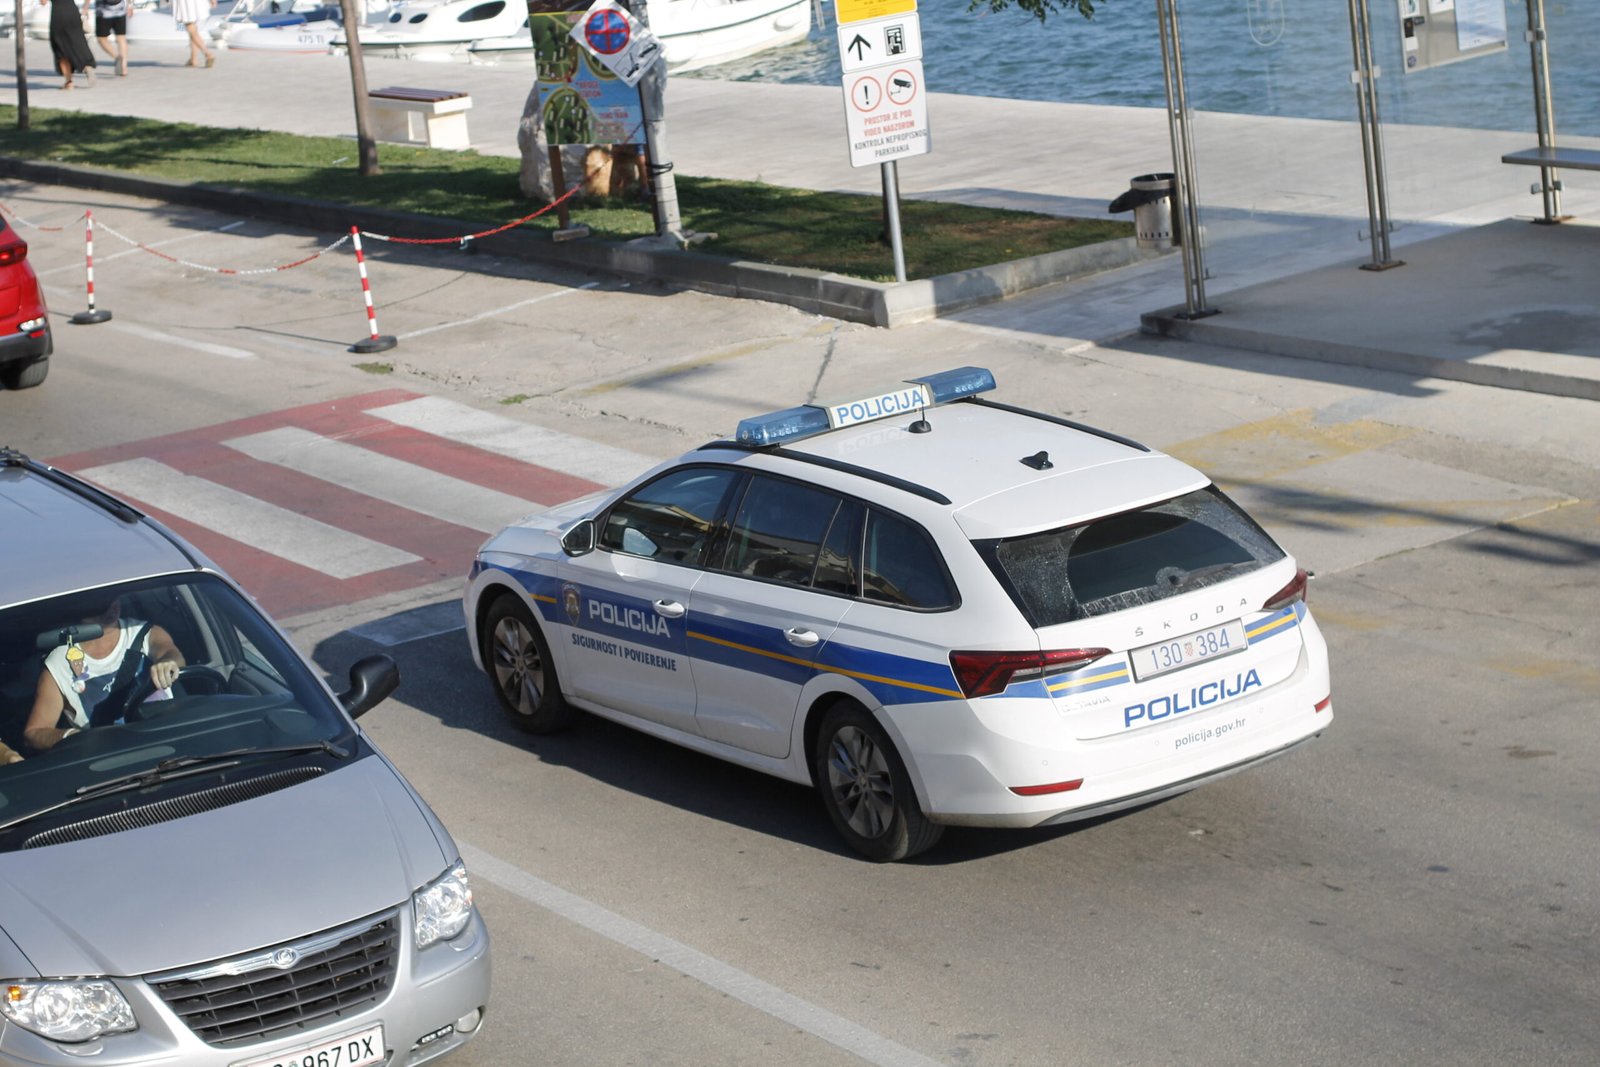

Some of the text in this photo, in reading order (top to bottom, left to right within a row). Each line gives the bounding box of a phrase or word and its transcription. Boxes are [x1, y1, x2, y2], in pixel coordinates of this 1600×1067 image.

[864, 109, 912, 126] PROSTOR JE POD
[864, 120, 915, 137] VIDEO NADZOROM
[855, 129, 928, 151] KONTROLA NEPROPISNOG
[837, 390, 925, 424] POLICIJA
[588, 599, 671, 639] POLICIJA
[1134, 598, 1248, 637] ŠKODA
[571, 633, 617, 655] SIGURNOST
[624, 648, 677, 671] POVJERENJE
[1151, 628, 1231, 671] 130 384
[1124, 668, 1263, 728] POLICIJA
[1174, 717, 1246, 750] policija.gov.hr
[302, 1035, 374, 1067] 967 DX
